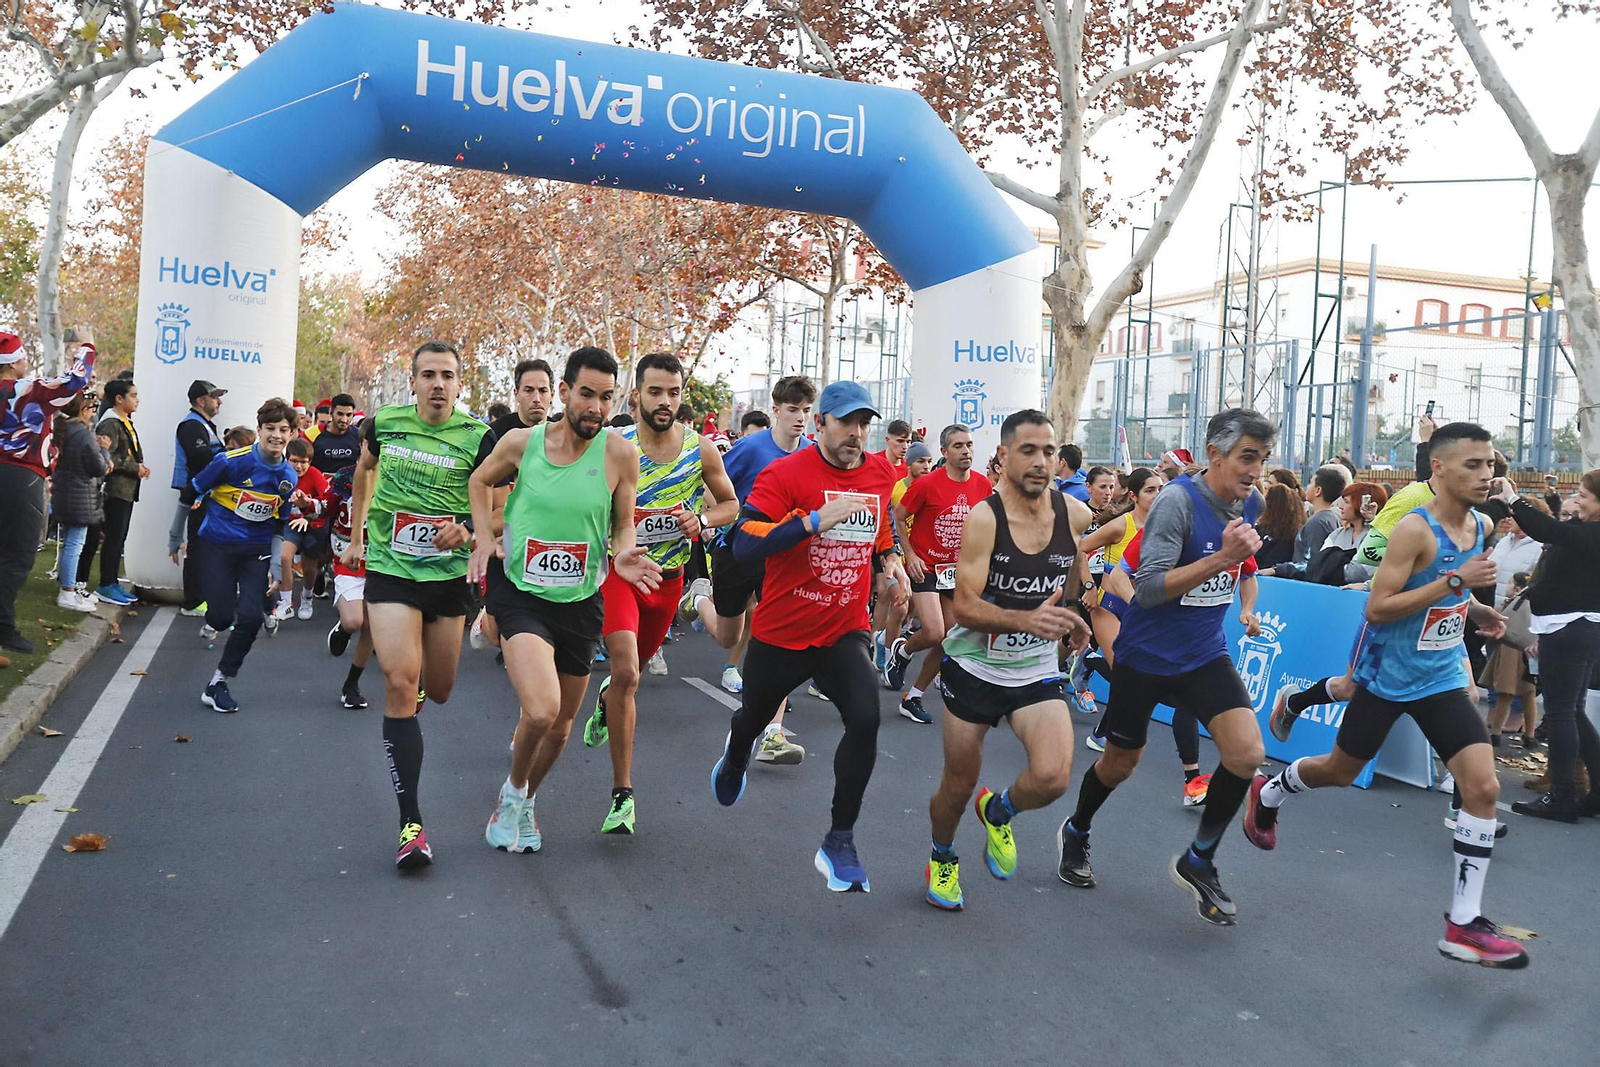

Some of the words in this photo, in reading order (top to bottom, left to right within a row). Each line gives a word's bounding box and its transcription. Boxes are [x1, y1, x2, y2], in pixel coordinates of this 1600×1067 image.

[415, 39, 643, 127] Huelva
[666, 85, 865, 158] original
[159, 256, 268, 293] Huelva
[228, 292, 267, 306] original
[195, 336, 253, 348] Ayuntamiento
[194, 346, 262, 364] HUELVA
[954, 340, 1036, 364] Huelva
[385, 443, 411, 458] MEDIO
[411, 450, 456, 469] MARATÓN
[247, 502, 269, 514] 485
[644, 515, 674, 533] 645
[538, 553, 571, 572] 463
[1202, 574, 1228, 593] 533
[1437, 615, 1461, 637] 629
